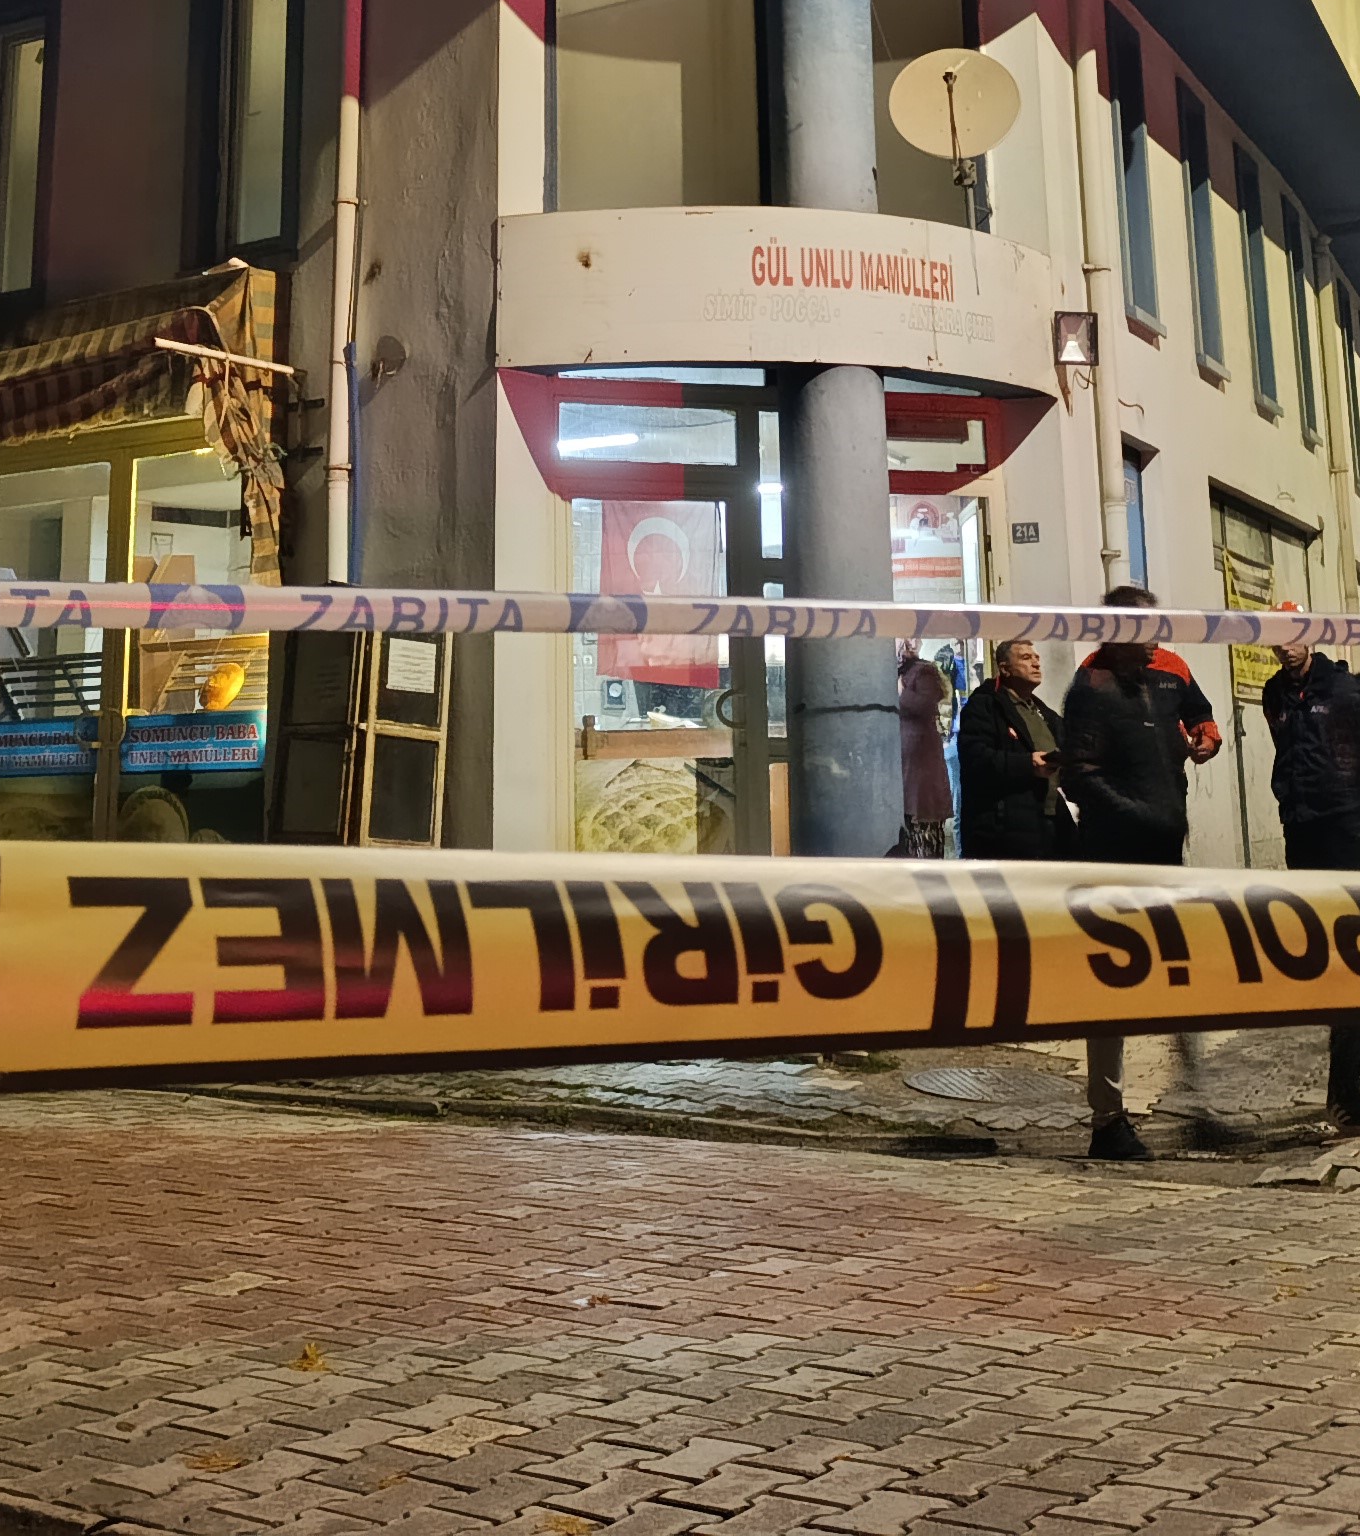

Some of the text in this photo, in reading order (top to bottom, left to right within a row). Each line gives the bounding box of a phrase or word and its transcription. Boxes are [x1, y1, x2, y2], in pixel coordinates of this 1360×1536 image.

[751, 237, 955, 303] GÜL UNLU MAMÜLLERİ
[1015, 524, 1036, 539] 21A
[293, 594, 524, 632] ZABITA
[689, 603, 878, 638] ZABITA
[1013, 612, 1174, 642] ZABITA
[130, 723, 258, 743] SOMUNCU BABA
[130, 744, 258, 765] UNLU MAMÜLLERİ
[67, 875, 884, 1030] GİRİLMEZ
